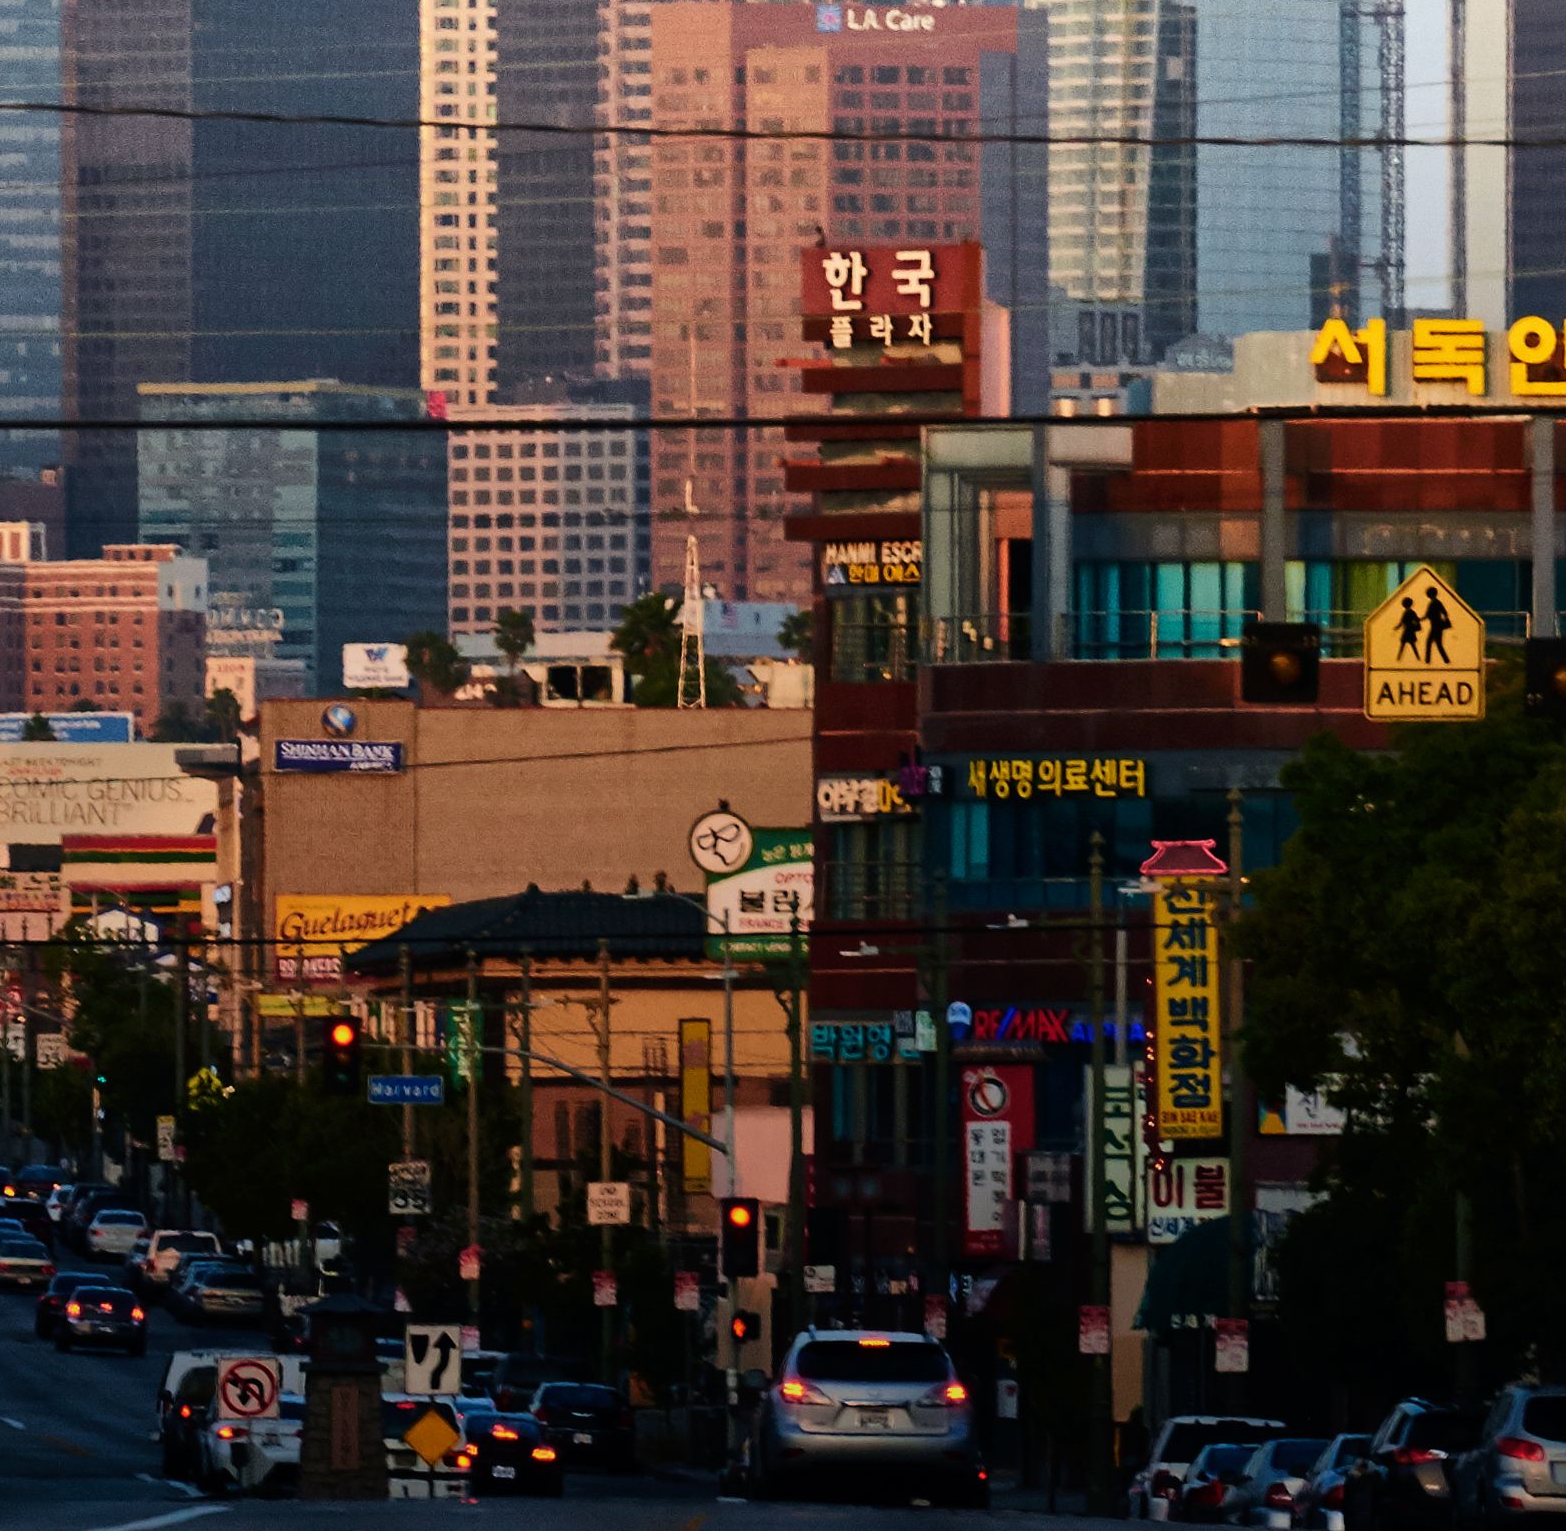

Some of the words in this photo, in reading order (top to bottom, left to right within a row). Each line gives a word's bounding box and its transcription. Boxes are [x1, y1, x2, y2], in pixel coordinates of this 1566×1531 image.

[885, 10, 936, 32] Care
[822, 249, 936, 312] 한국
[829, 313, 934, 349] 플라자
[1375, 680, 1474, 707] AHEAD
[973, 1005, 1071, 1045] RE/MAX
